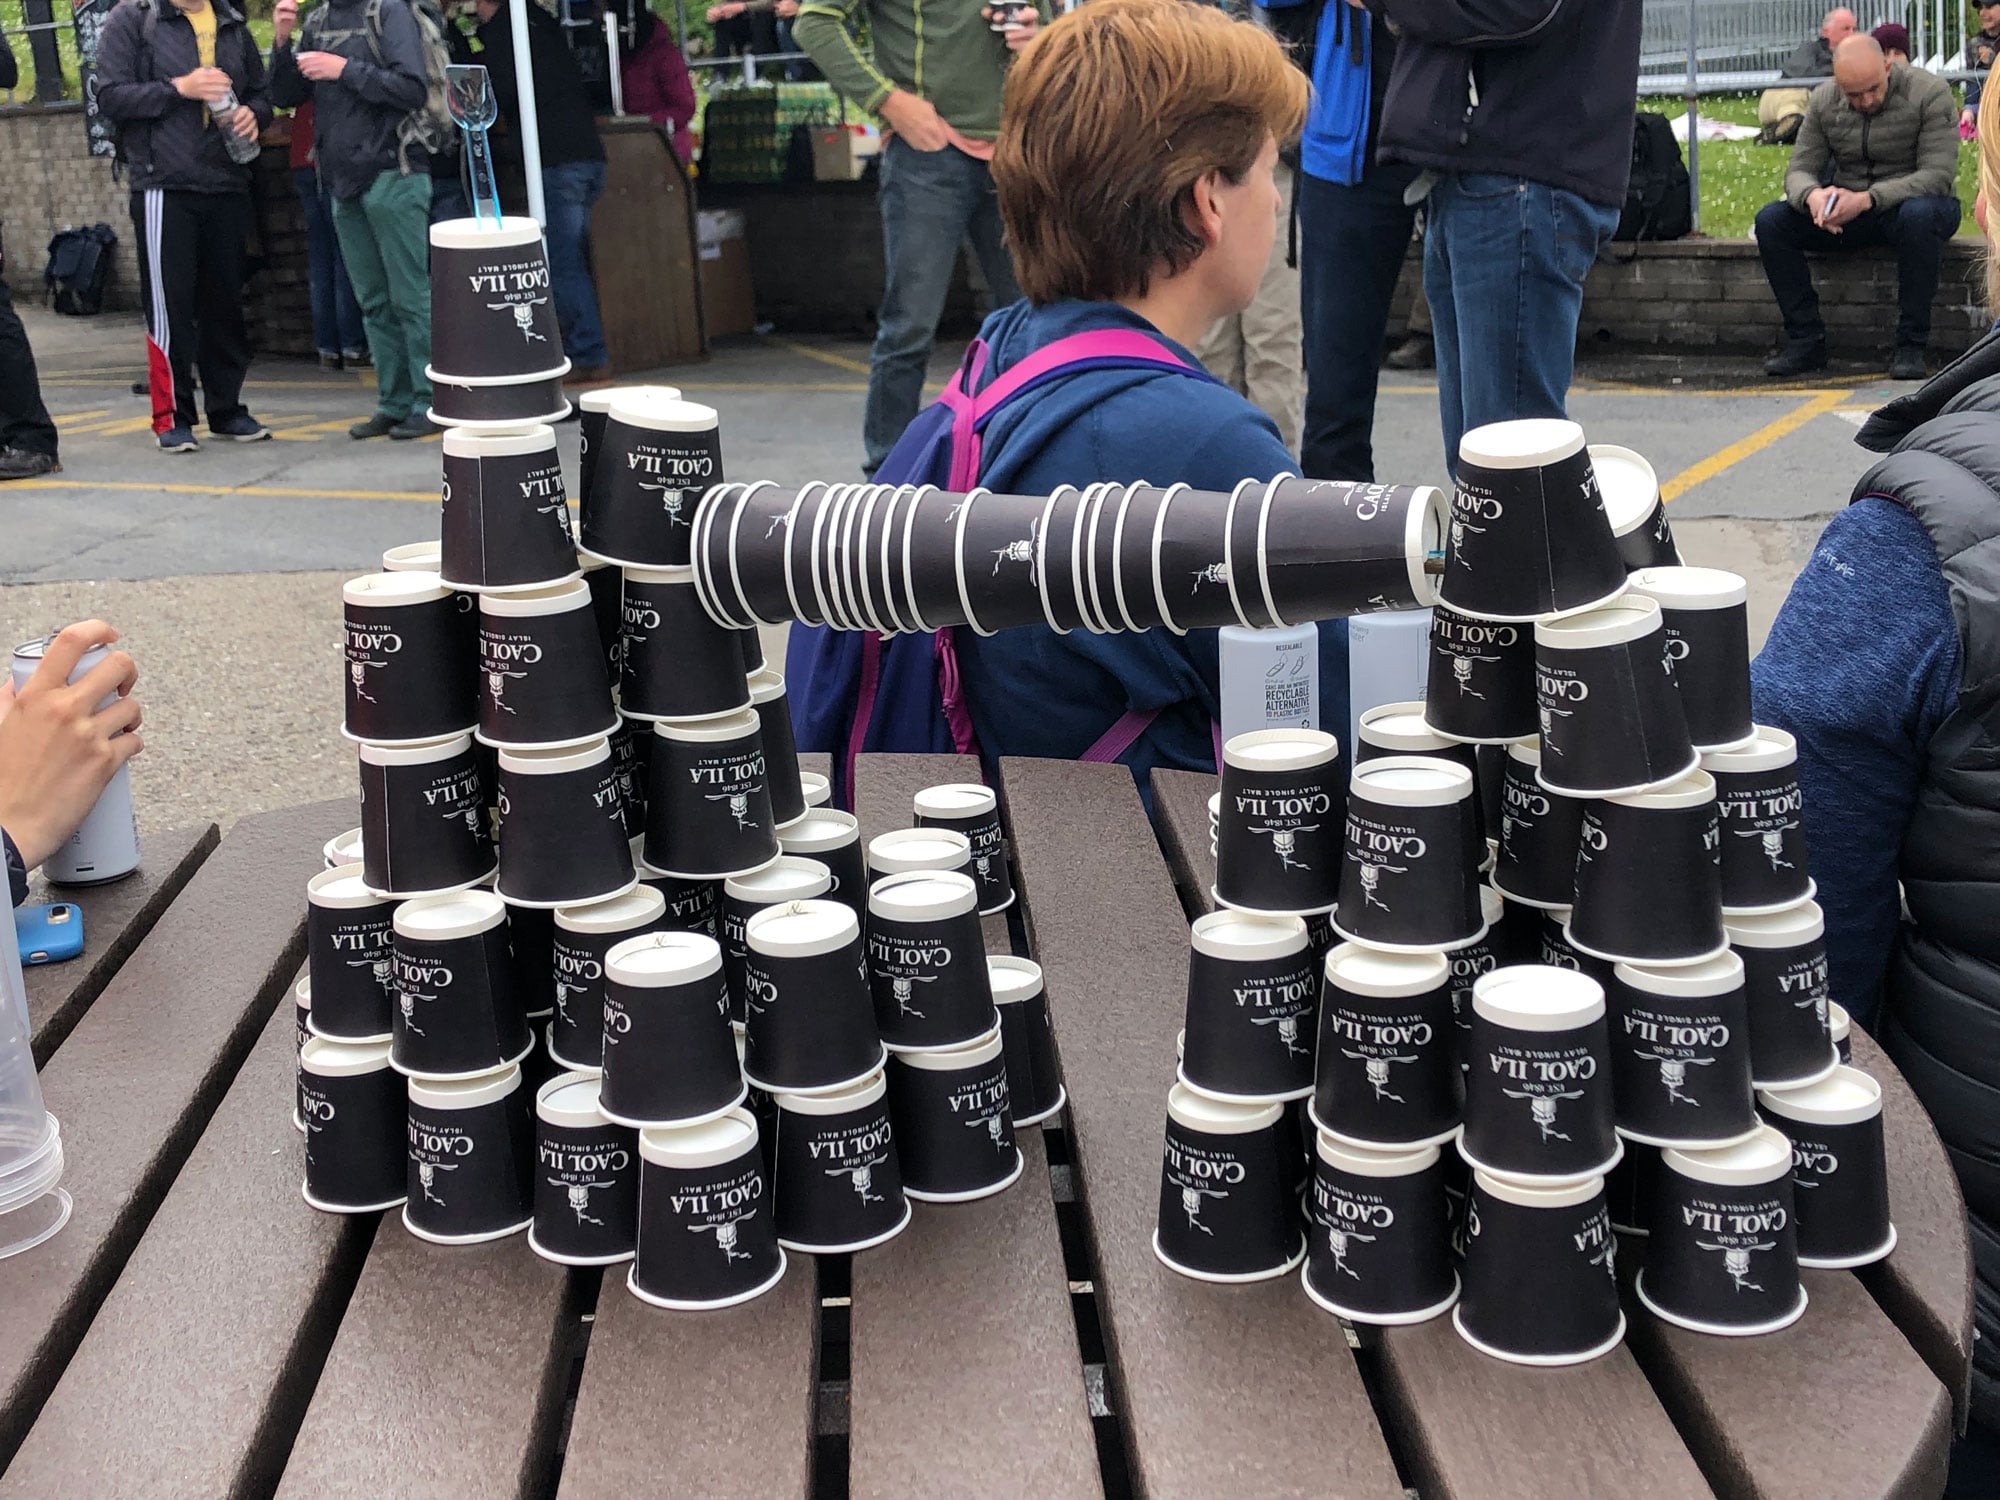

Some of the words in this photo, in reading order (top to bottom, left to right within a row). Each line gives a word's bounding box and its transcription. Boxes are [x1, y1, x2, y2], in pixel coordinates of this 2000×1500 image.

[478, 265, 499, 273] MALT
[503, 262, 528, 271] SINGLE
[469, 274, 507, 293] ILA
[510, 267, 549, 290] CAOL
[636, 444, 657, 454] MALT
[661, 447, 689, 456] SINGLE
[628, 452, 661, 474] ILA
[668, 457, 712, 477] CAOL
[519, 478, 551, 498] ILA
[1470, 485, 1492, 496] ISLAY
[1455, 488, 1503, 520] CAOL
[369, 624, 391, 632] ISLAY
[1433, 615, 1452, 639] ILA
[1456, 625, 1518, 647] CAOL
[351, 633, 402, 653] CAOL
[489, 642, 542, 663] CAOL
[1553, 669, 1576, 677] ISLAY
[1266, 685, 1309, 700] RECYCLABLE
[1538, 674, 1589, 702] CAOL
[1266, 696, 1309, 711] ALTERNATIVE
[722, 753, 747, 765] SINGLE
[729, 756, 765, 781] CAOL
[431, 776, 452, 786] MALT
[689, 767, 724, 783] ILA
[423, 784, 458, 805] ILA
[592, 784, 617, 807] ILA
[1242, 788, 1262, 796] MALT
[1299, 785, 1321, 794] ISLAY
[1235, 796, 1268, 816] ILA
[1272, 793, 1330, 816] CAOL
[1506, 784, 1550, 816] CAOL
[1717, 801, 1758, 819] ILA
[1762, 788, 1803, 816] CAOL
[1360, 817, 1386, 831] SINGLE
[1389, 826, 1415, 834] ISLAY
[974, 826, 1002, 847] CAOL
[1364, 831, 1426, 858] CAOL
[670, 896, 701, 917] ILA
[338, 924, 359, 932] MALT
[724, 919, 744, 942] ILA
[331, 933, 366, 950] ILA
[889, 936, 915, 946] SINGLE
[918, 938, 941, 946] ISLAY
[571, 949, 592, 958] ISLAY
[869, 939, 889, 964] ILA
[894, 947, 951, 966] CAOL
[419, 958, 442, 966] ISLAY
[557, 952, 602, 979] CAOL
[401, 962, 453, 987] CAOL
[1242, 979, 1266, 987] MALT
[1777, 970, 1813, 993] ILA
[1233, 988, 1273, 1007] ILA
[1331, 1013, 1363, 1041] ILA
[1360, 1013, 1393, 1024] SINGLE
[1367, 1022, 1433, 1046] CAOL
[1623, 1015, 1659, 1043] ILA
[1663, 1025, 1730, 1048] CAOL
[1525, 1050, 1560, 1059] SINGLE
[1489, 1052, 1528, 1080] ILA
[1532, 1055, 1597, 1081] CAOL
[957, 1083, 977, 1093] MALT
[948, 1094, 983, 1112] ILA
[817, 1131, 839, 1140] MALT
[843, 1124, 870, 1137] SINGLE
[850, 1121, 892, 1154] CAOL
[419, 1133, 474, 1156] CAOL
[543, 1139, 560, 1149] MALT
[561, 1143, 591, 1151] SINGLE
[594, 1142, 618, 1151] ISLAY
[808, 1140, 845, 1159] ILA
[539, 1145, 563, 1168] ILA
[568, 1150, 629, 1171] CAOL
[1185, 1155, 1245, 1184] CAOL
[679, 1185, 702, 1195] MALT
[705, 1178, 736, 1192] SINGLE
[714, 1176, 762, 1208] CAOL
[670, 1195, 709, 1214] ILA
[1332, 1196, 1394, 1228] CAOL
[1682, 1206, 1723, 1233] ILA
[1728, 1207, 1787, 1235] CAOL
[1574, 1223, 1603, 1252] ILA
